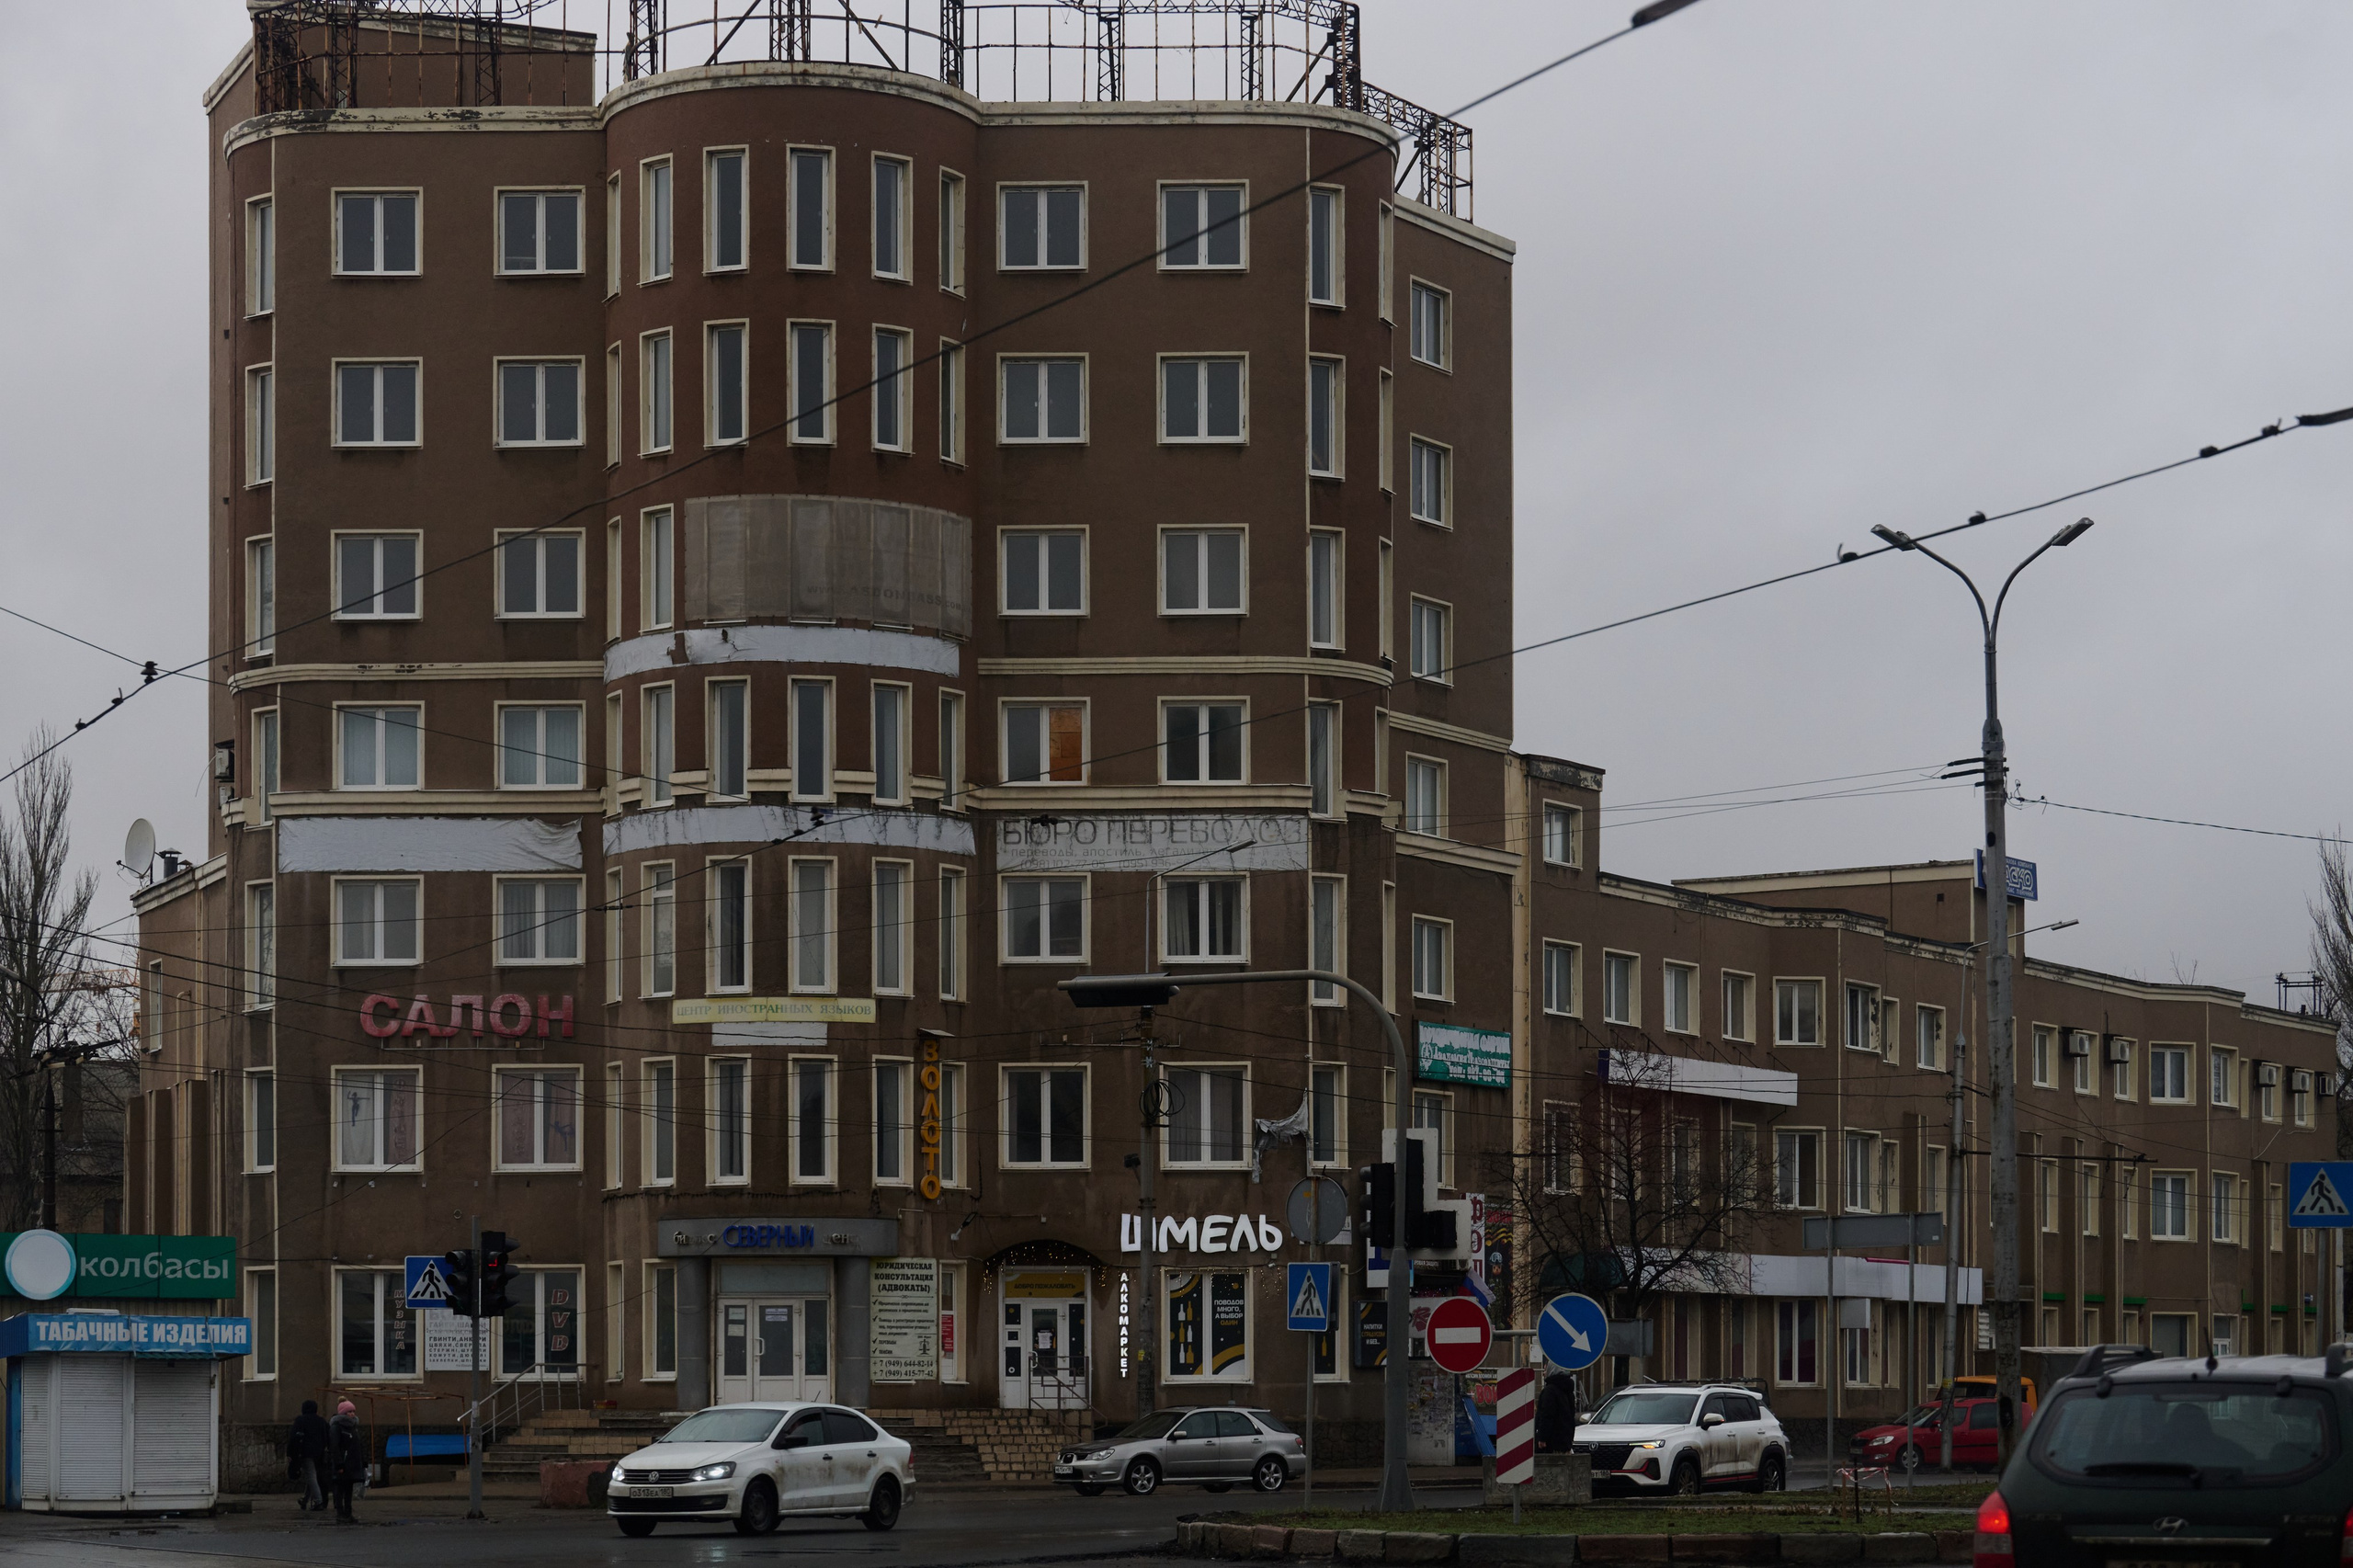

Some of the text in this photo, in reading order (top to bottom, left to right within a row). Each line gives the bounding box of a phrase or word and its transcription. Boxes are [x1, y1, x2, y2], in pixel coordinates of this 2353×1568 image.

[1004, 821, 1097, 845] БЮРО
[360, 994, 574, 1038] САЛОН
[676, 1005, 871, 1016] ЦЕНТР ИНОСТРАННЫХ ЯЗЫКОВ
[920, 1040, 940, 1199] ЗОЛОТО
[1120, 1213, 1283, 1254] ШМЕЛЬ
[80, 1251, 229, 1279] колбасы
[875, 1273, 933, 1281] КОНСУЛЬТАЦИЯ
[876, 1262, 932, 1271] ЮРИДИЧЕСКАЯ
[878, 1284, 930, 1293] (АДВОКАТЫ)
[36, 1321, 246, 1346] ТАБАЧНЫЕ ИЗДЕЛИЯ
[393, 1290, 405, 1349] МУЗЫКА
[551, 1289, 570, 1351] DVD
[1119, 1272, 1130, 1378] АЛКОМАРКЕТ
